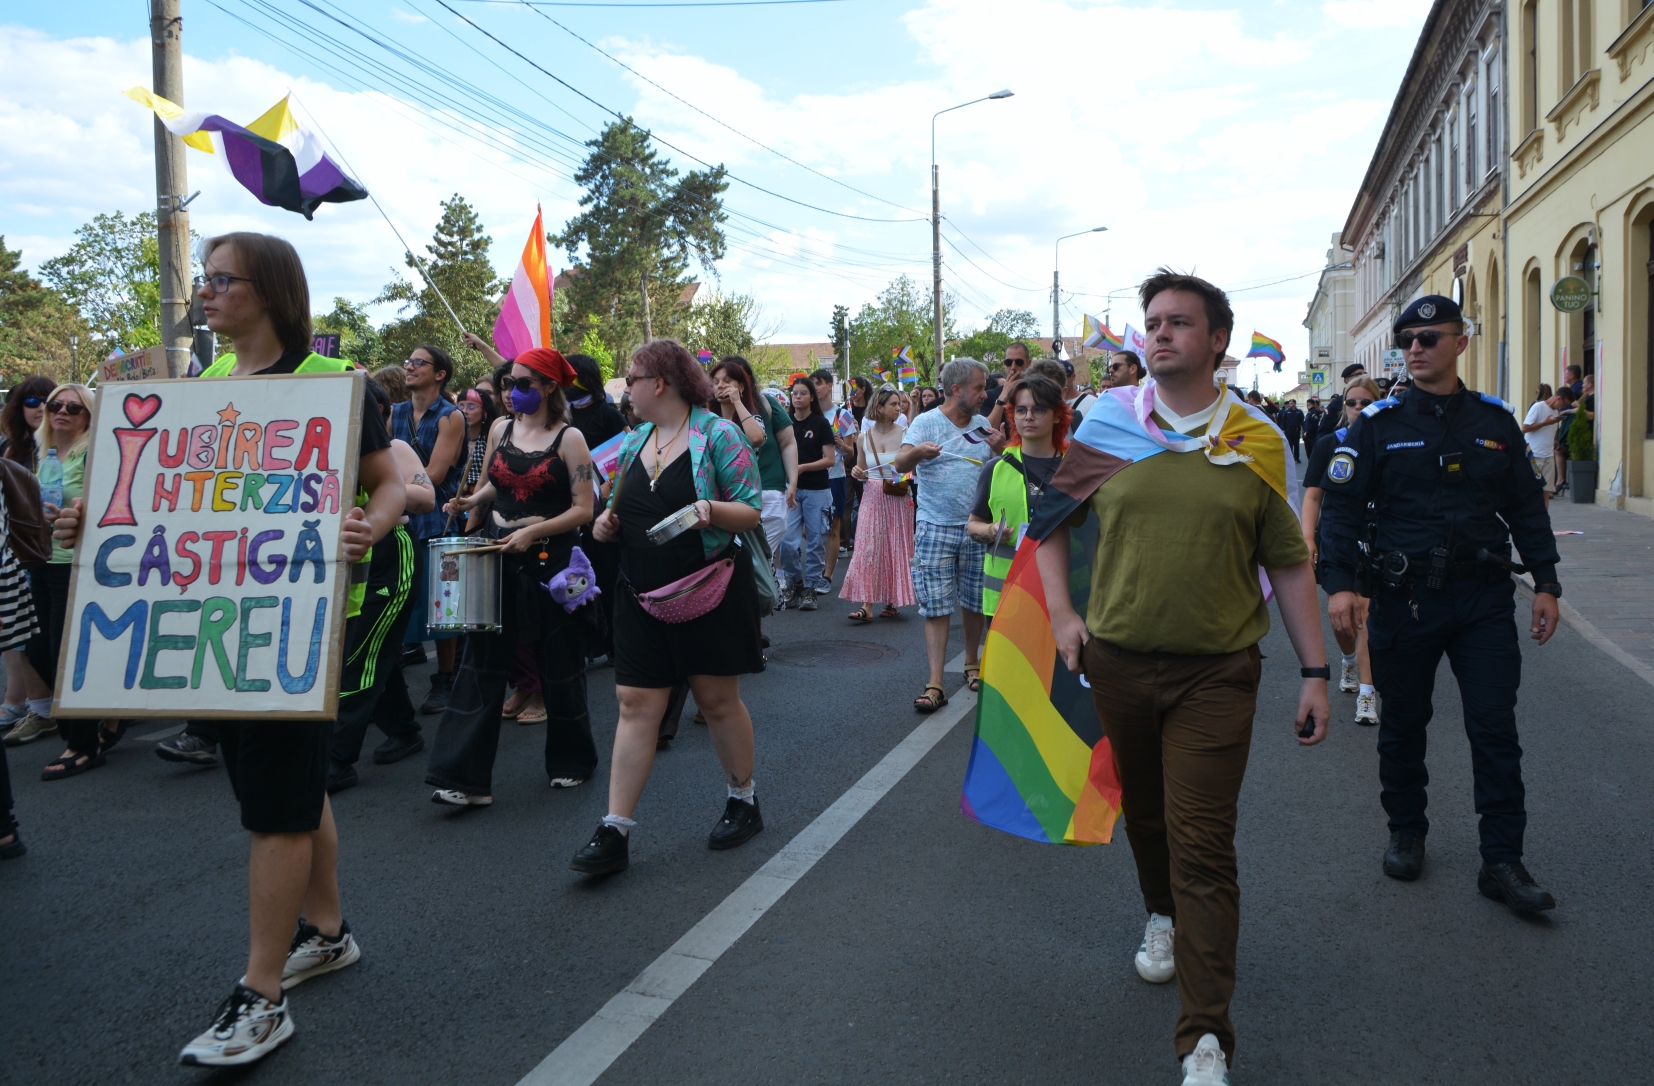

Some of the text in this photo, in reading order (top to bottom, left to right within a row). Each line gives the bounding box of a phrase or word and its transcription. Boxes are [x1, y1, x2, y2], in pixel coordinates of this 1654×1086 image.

[1555, 293, 1588, 301] PANINO
[309, 336, 336, 358] ALE
[1386, 440, 1425, 450] JANDARMERIA
[94, 519, 327, 595] CÂȘTIGĂ
[72, 595, 328, 694] MEREU
